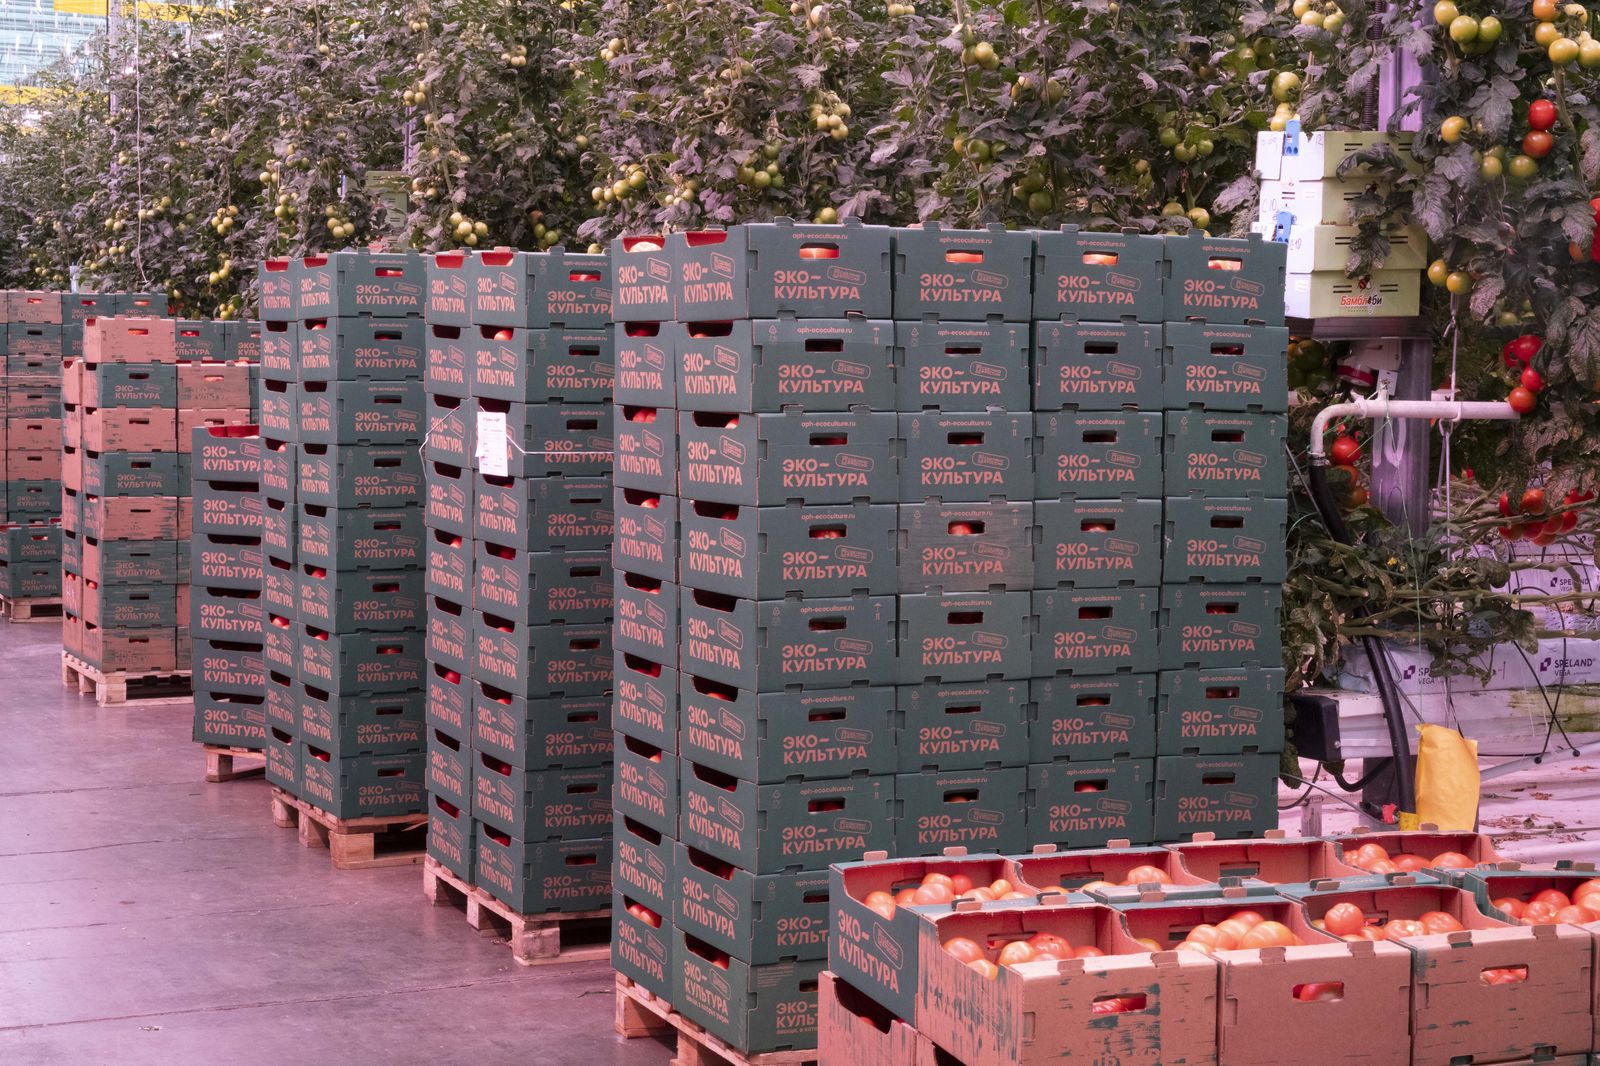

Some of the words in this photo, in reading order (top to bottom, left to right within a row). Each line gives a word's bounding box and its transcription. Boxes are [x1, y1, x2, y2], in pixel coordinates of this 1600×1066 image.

[619, 285, 668, 304] КУЛЬТУРА
[684, 282, 733, 303] КУЛЬТУРА
[774, 285, 860, 299] КУЛЬТУРА
[920, 288, 1002, 303] КУЛЬТУРА
[1057, 290, 1135, 304] КУЛЬТУРА
[356, 295, 417, 305] КУЛЬТУРА
[477, 295, 515, 312] КУЛЬТУРА
[1184, 293, 1258, 309] КУЛЬТУРА
[355, 358, 416, 368] КУЛЬТУРА
[430, 365, 464, 383] КУЛЬТУРА
[477, 368, 515, 386] КУЛЬТУРА
[620, 370, 662, 389] КУЛЬТУРА
[547, 376, 614, 389] КУЛЬТУРА
[684, 375, 736, 394] КУЛЬТУРА
[779, 379, 864, 393] КУЛЬТУРА
[920, 381, 1001, 394] КУЛЬТУРА
[1060, 380, 1135, 393] КУЛЬТУРА
[1186, 379, 1261, 393] КУЛЬТУРА
[620, 454, 662, 476] КУЛЬТУРА
[689, 463, 742, 485] КУЛЬТУРА
[783, 473, 867, 487] КУЛЬТУРА
[922, 471, 1003, 485] КУЛЬТУРА
[1058, 468, 1135, 481] КУЛЬТУРА
[1188, 467, 1261, 480] КУЛЬТУРА
[355, 485, 416, 496] КУЛЬТУРА
[203, 512, 263, 526] КУЛЬТУРА
[548, 525, 615, 537] КУЛЬТУРА
[620, 536, 663, 562] КУЛЬТУРА
[689, 550, 744, 578] КУЛЬТУРА
[1056, 557, 1133, 570] КУЛЬТУРА
[1187, 553, 1260, 566] КУЛЬТУРА
[202, 565, 264, 579] КУЛЬТУРА
[783, 564, 867, 580] КУЛЬТУРА
[922, 560, 1003, 575] КУЛЬТУРА
[1559, 578, 1590, 586] SPEND
[480, 582, 518, 607] КУЛЬТУРА
[201, 617, 263, 632] КУЛЬТУРА
[620, 619, 664, 647] КУЛЬТУРА
[431, 634, 464, 660] КУЛЬТУРА
[1055, 644, 1131, 659] КУЛЬТУРА
[1182, 639, 1254, 652] КУЛЬТУРА
[689, 638, 741, 670] КУЛЬТУРА
[923, 649, 1002, 665] КУЛЬТУРА
[783, 657, 866, 672] КУЛЬТУРА
[204, 670, 266, 685] КУЛЬТУРА
[357, 671, 417, 682] КУЛЬТУРА
[620, 699, 665, 732] КУЛЬТУРА
[205, 722, 267, 738] КУЛЬТУРА
[1181, 723, 1256, 737] КУЛЬТУРА
[689, 726, 742, 760] КУЛЬТУРА
[1052, 731, 1128, 745] КУЛЬТУРА
[545, 743, 614, 757] КУЛЬТУРА
[920, 738, 999, 754] КУЛЬТУРА
[784, 747, 867, 765] КУЛЬТУРА
[1178, 810, 1251, 823] КУЛЬТУРА
[1049, 817, 1125, 832] КУЛЬТУРА
[918, 826, 997, 843] КУЛЬТУРА
[783, 836, 865, 854] КУЛЬТУРА
[683, 898, 737, 940] КУЛЬТУРА
[777, 929, 829, 946] КУЛЬТ
[619, 940, 663, 982] КУЛЬТУРА
[839, 939, 901, 994] КУЛЬТУРА
